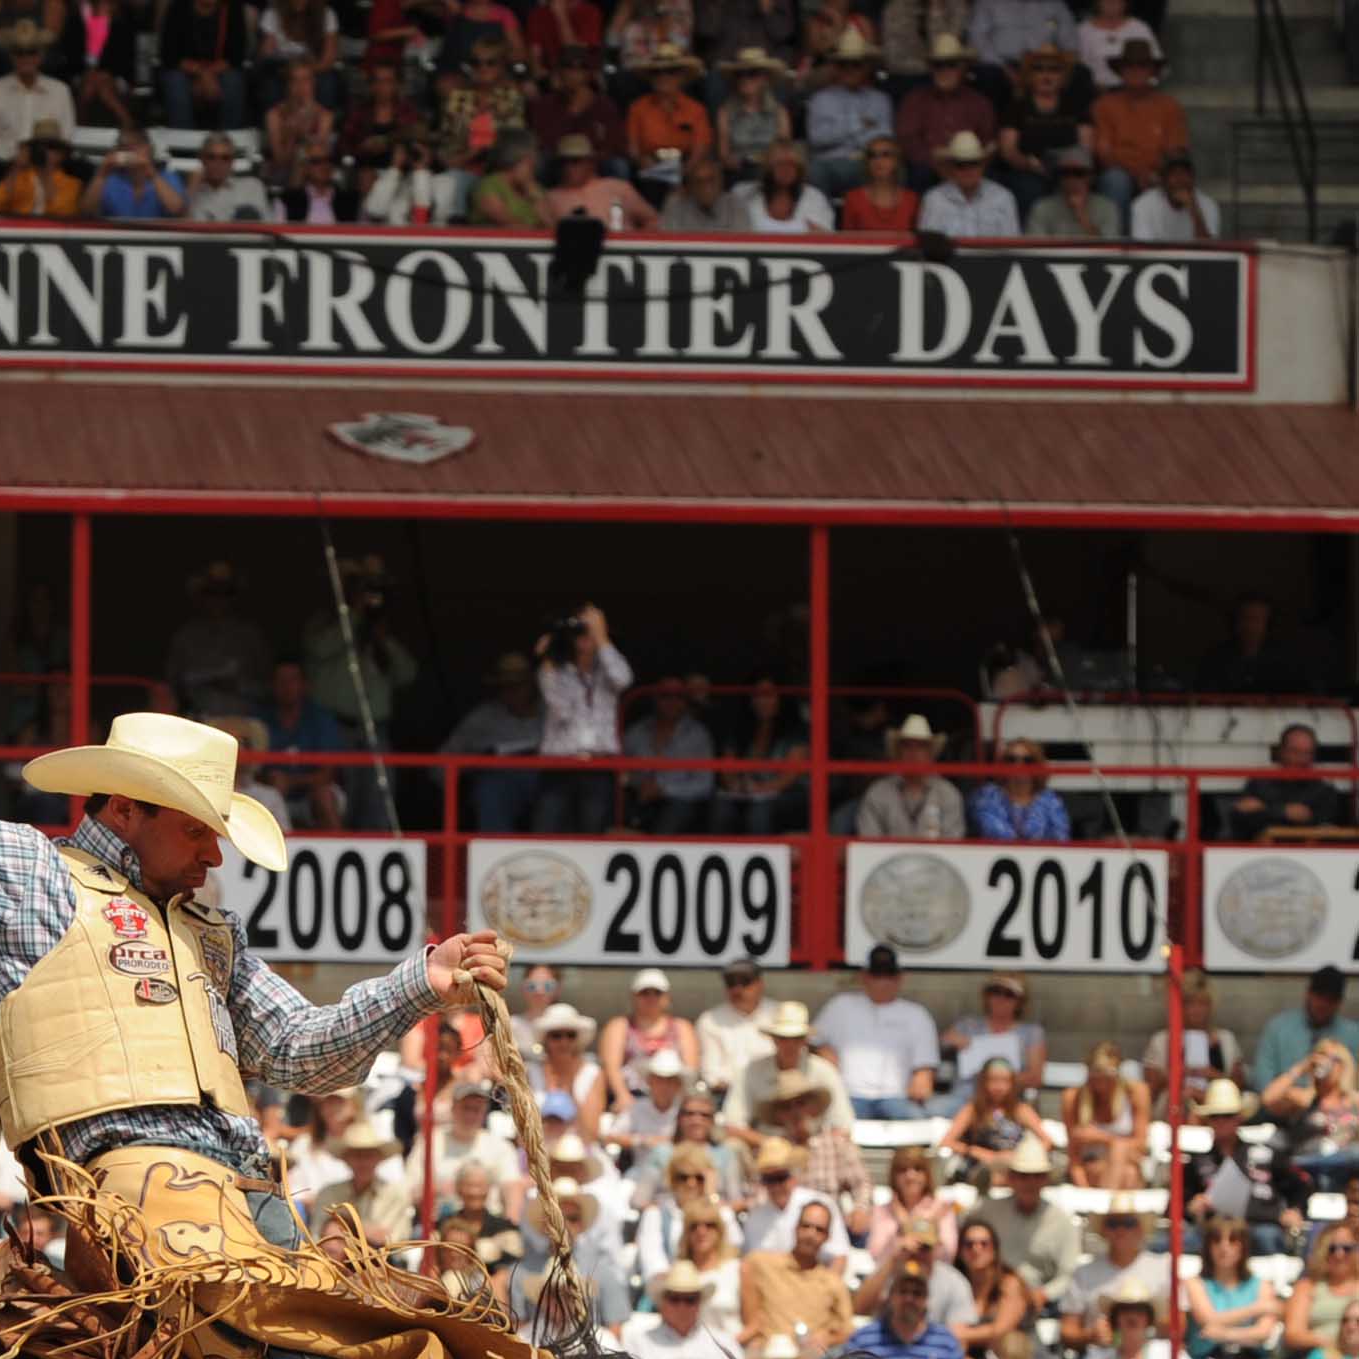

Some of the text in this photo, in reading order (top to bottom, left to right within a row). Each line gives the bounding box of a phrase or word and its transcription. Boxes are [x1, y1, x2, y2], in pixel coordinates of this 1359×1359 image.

[229, 246, 841, 361] FRONTIER
[891, 260, 1193, 369] DAYS
[243, 849, 413, 952] 2008
[603, 853, 778, 956] 2009
[985, 857, 1156, 961] 2010
[117, 958, 169, 971] PRORODEO
